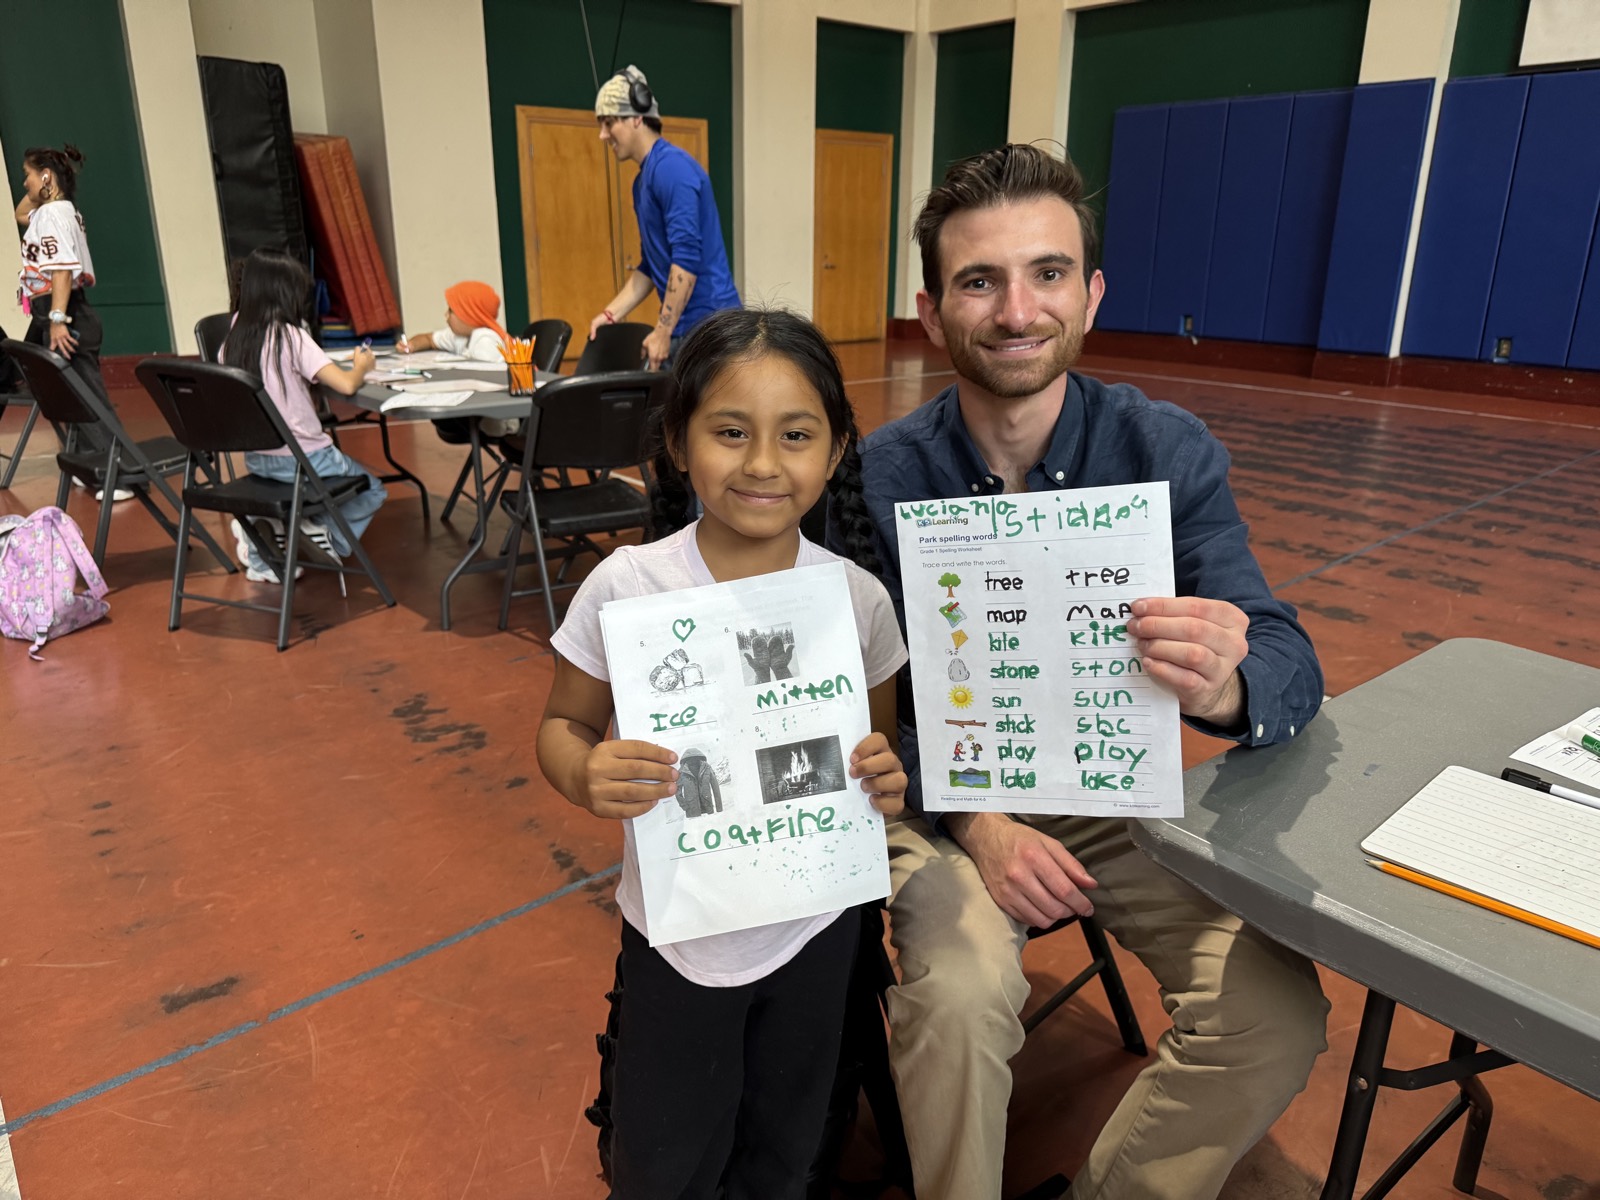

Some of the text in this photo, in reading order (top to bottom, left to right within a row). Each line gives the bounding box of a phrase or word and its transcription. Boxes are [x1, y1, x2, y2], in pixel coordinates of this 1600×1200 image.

[932, 515, 969, 526] Learning
[919, 532, 998, 544] Park spelling words
[973, 559, 985, 567] the
[985, 558, 1008, 566] words.
[984, 571, 1023, 591] tree
[1066, 567, 1130, 587] tree
[987, 609, 1027, 625] map
[989, 660, 1040, 680] stone
[992, 696, 1022, 708] sun
[995, 713, 1036, 735] stick
